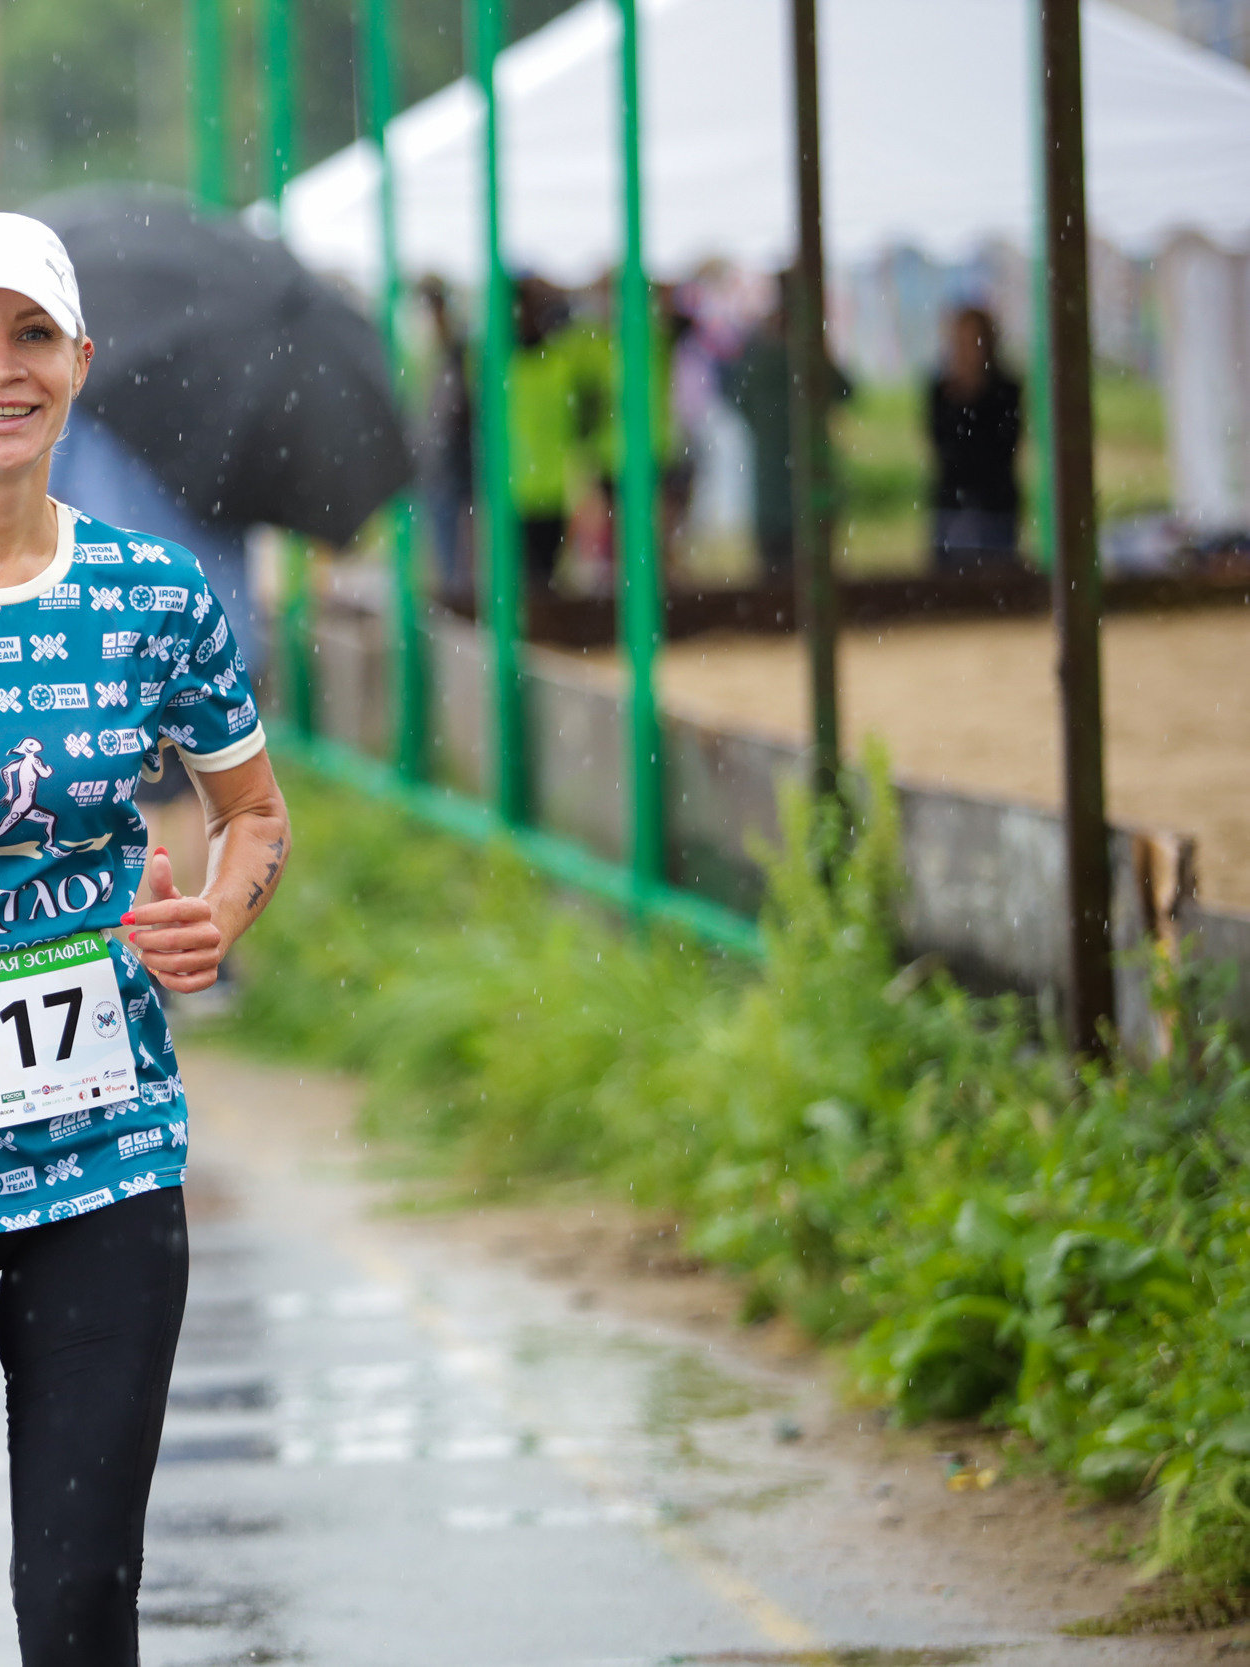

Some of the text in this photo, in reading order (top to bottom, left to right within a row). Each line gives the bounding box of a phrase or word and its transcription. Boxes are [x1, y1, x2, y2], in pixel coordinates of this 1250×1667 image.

[159, 590, 182, 599] IRON
[38, 598, 80, 606] TRIATHLON
[159, 601, 183, 610] TEAM
[57, 687, 80, 696] IRON
[59, 698, 86, 706] TEAM
[123, 741, 139, 751] TEAM
[23, 939, 99, 968] ЭСТАФЕТА
[50, 1119, 92, 1138] TRIATHLON
[119, 1140, 163, 1156] TRIATHLON
[5, 1170, 28, 1182] IRON
[7, 1179, 34, 1192] TEAM
[79, 1193, 105, 1206] IRON
